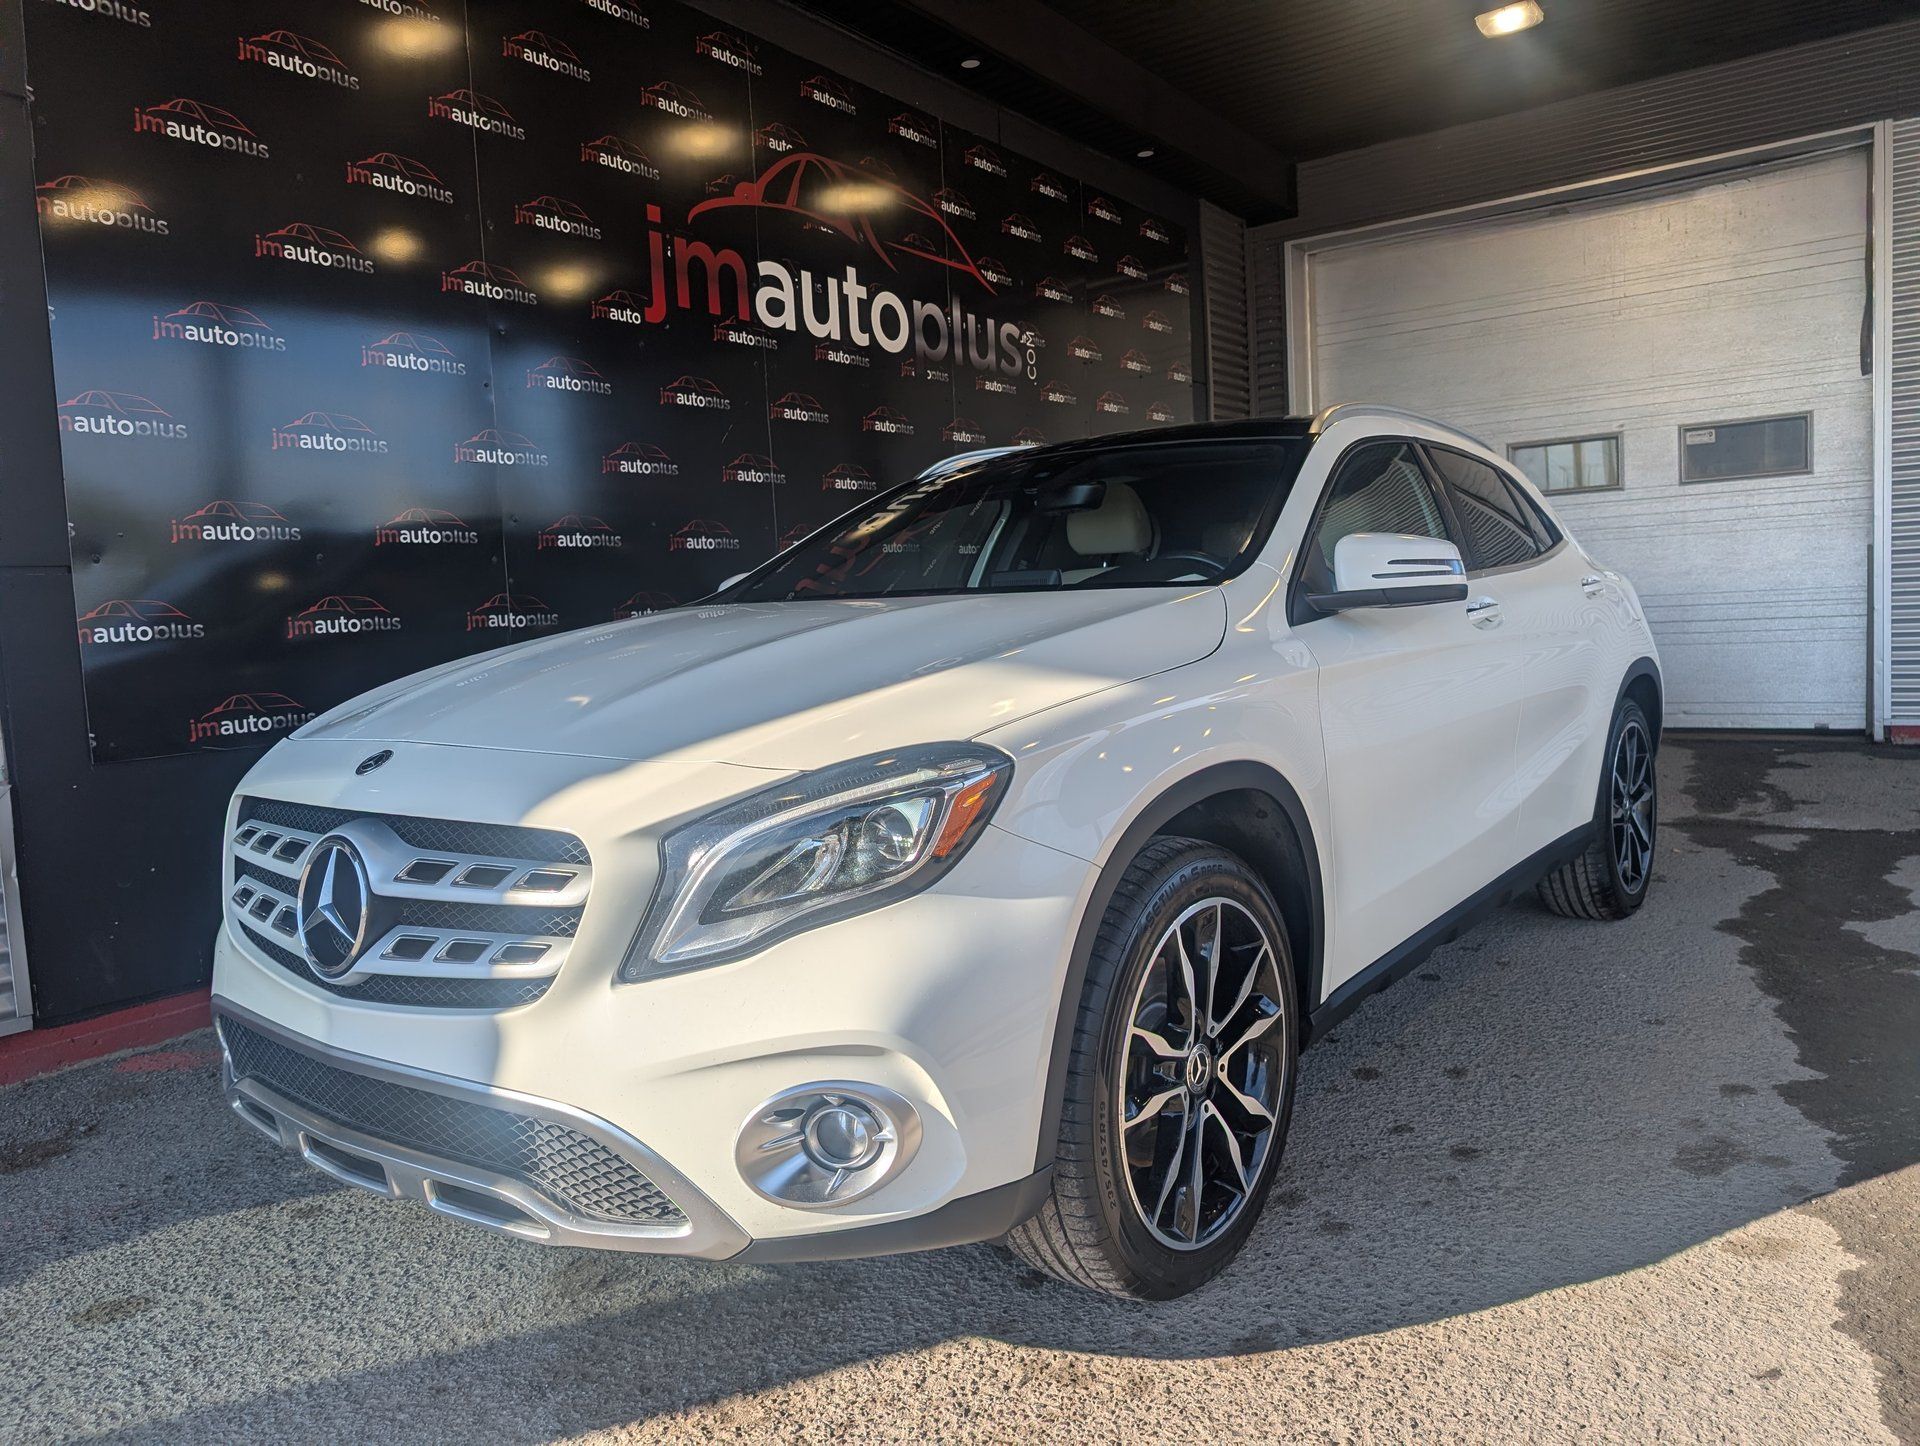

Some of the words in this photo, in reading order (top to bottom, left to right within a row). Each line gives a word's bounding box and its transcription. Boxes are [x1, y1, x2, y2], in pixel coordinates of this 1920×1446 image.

[238, 37, 360, 90] jmautoplus
[502, 37, 591, 83] jmautoplus
[696, 35, 763, 77] jmautoplus
[800, 81, 857, 116] jmautoplus
[428, 96, 526, 141] jmautoplus
[134, 107, 269, 159] jmautoplus
[888, 118, 937, 149] jmautoplus
[580, 142, 660, 181] jmautoplus
[346, 161, 454, 205] jmautoplus
[515, 205, 601, 240] jmautoplus
[255, 234, 374, 274] jmautoplus
[441, 272, 537, 305] jmautoplus
[645, 203, 1022, 378] jmautoplus
[153, 315, 286, 352] jmautoplus
[713, 324, 778, 350] jmautoplus
[361, 345, 466, 376] jmautoplus
[815, 345, 870, 367] jmautoplus
[526, 370, 612, 395] jmautoplus
[660, 387, 731, 410] jmautoplus
[770, 403, 829, 424] jmautoplus
[863, 417, 914, 435] jmautoplus
[272, 427, 388, 454] jmautoplus
[454, 443, 549, 466] jmautoplus
[602, 456, 679, 475] jmautoplus
[722, 466, 786, 485] jmautoplus
[822, 474, 877, 491] jmautoplus
[171, 520, 300, 543] jmautoplus
[375, 525, 478, 547] jmautoplus
[537, 531, 622, 550] jmautoplus
[669, 534, 740, 551] jmautoplus
[287, 615, 401, 639] jmautoplus
[466, 612, 559, 631] jmautoplus
